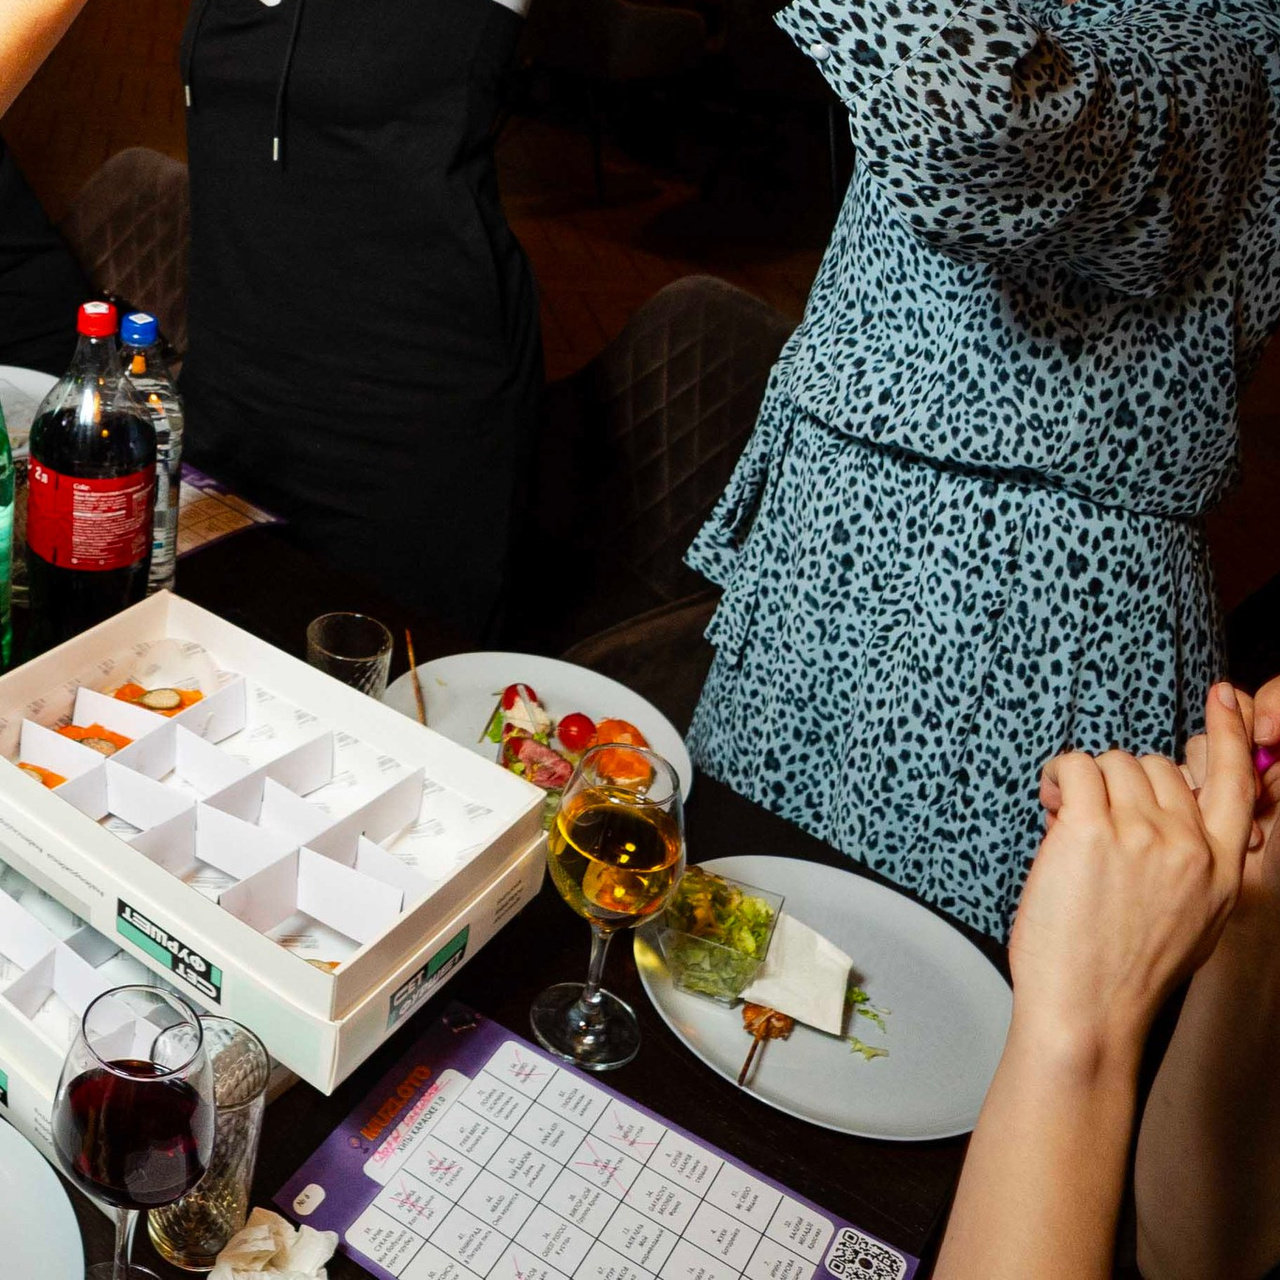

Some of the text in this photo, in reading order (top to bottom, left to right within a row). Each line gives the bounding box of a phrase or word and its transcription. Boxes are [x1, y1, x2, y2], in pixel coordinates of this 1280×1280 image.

[122, 906, 206, 972] ФУРШЕТ
[175, 964, 217, 998] СЕТ
[392, 967, 427, 1007] СЕТ
[359, 1064, 431, 1141] MUZLOTO
[410, 1106, 438, 1135] КАРАОКЕ
[457, 1226, 482, 1255] ЛЕНИНГРАД
